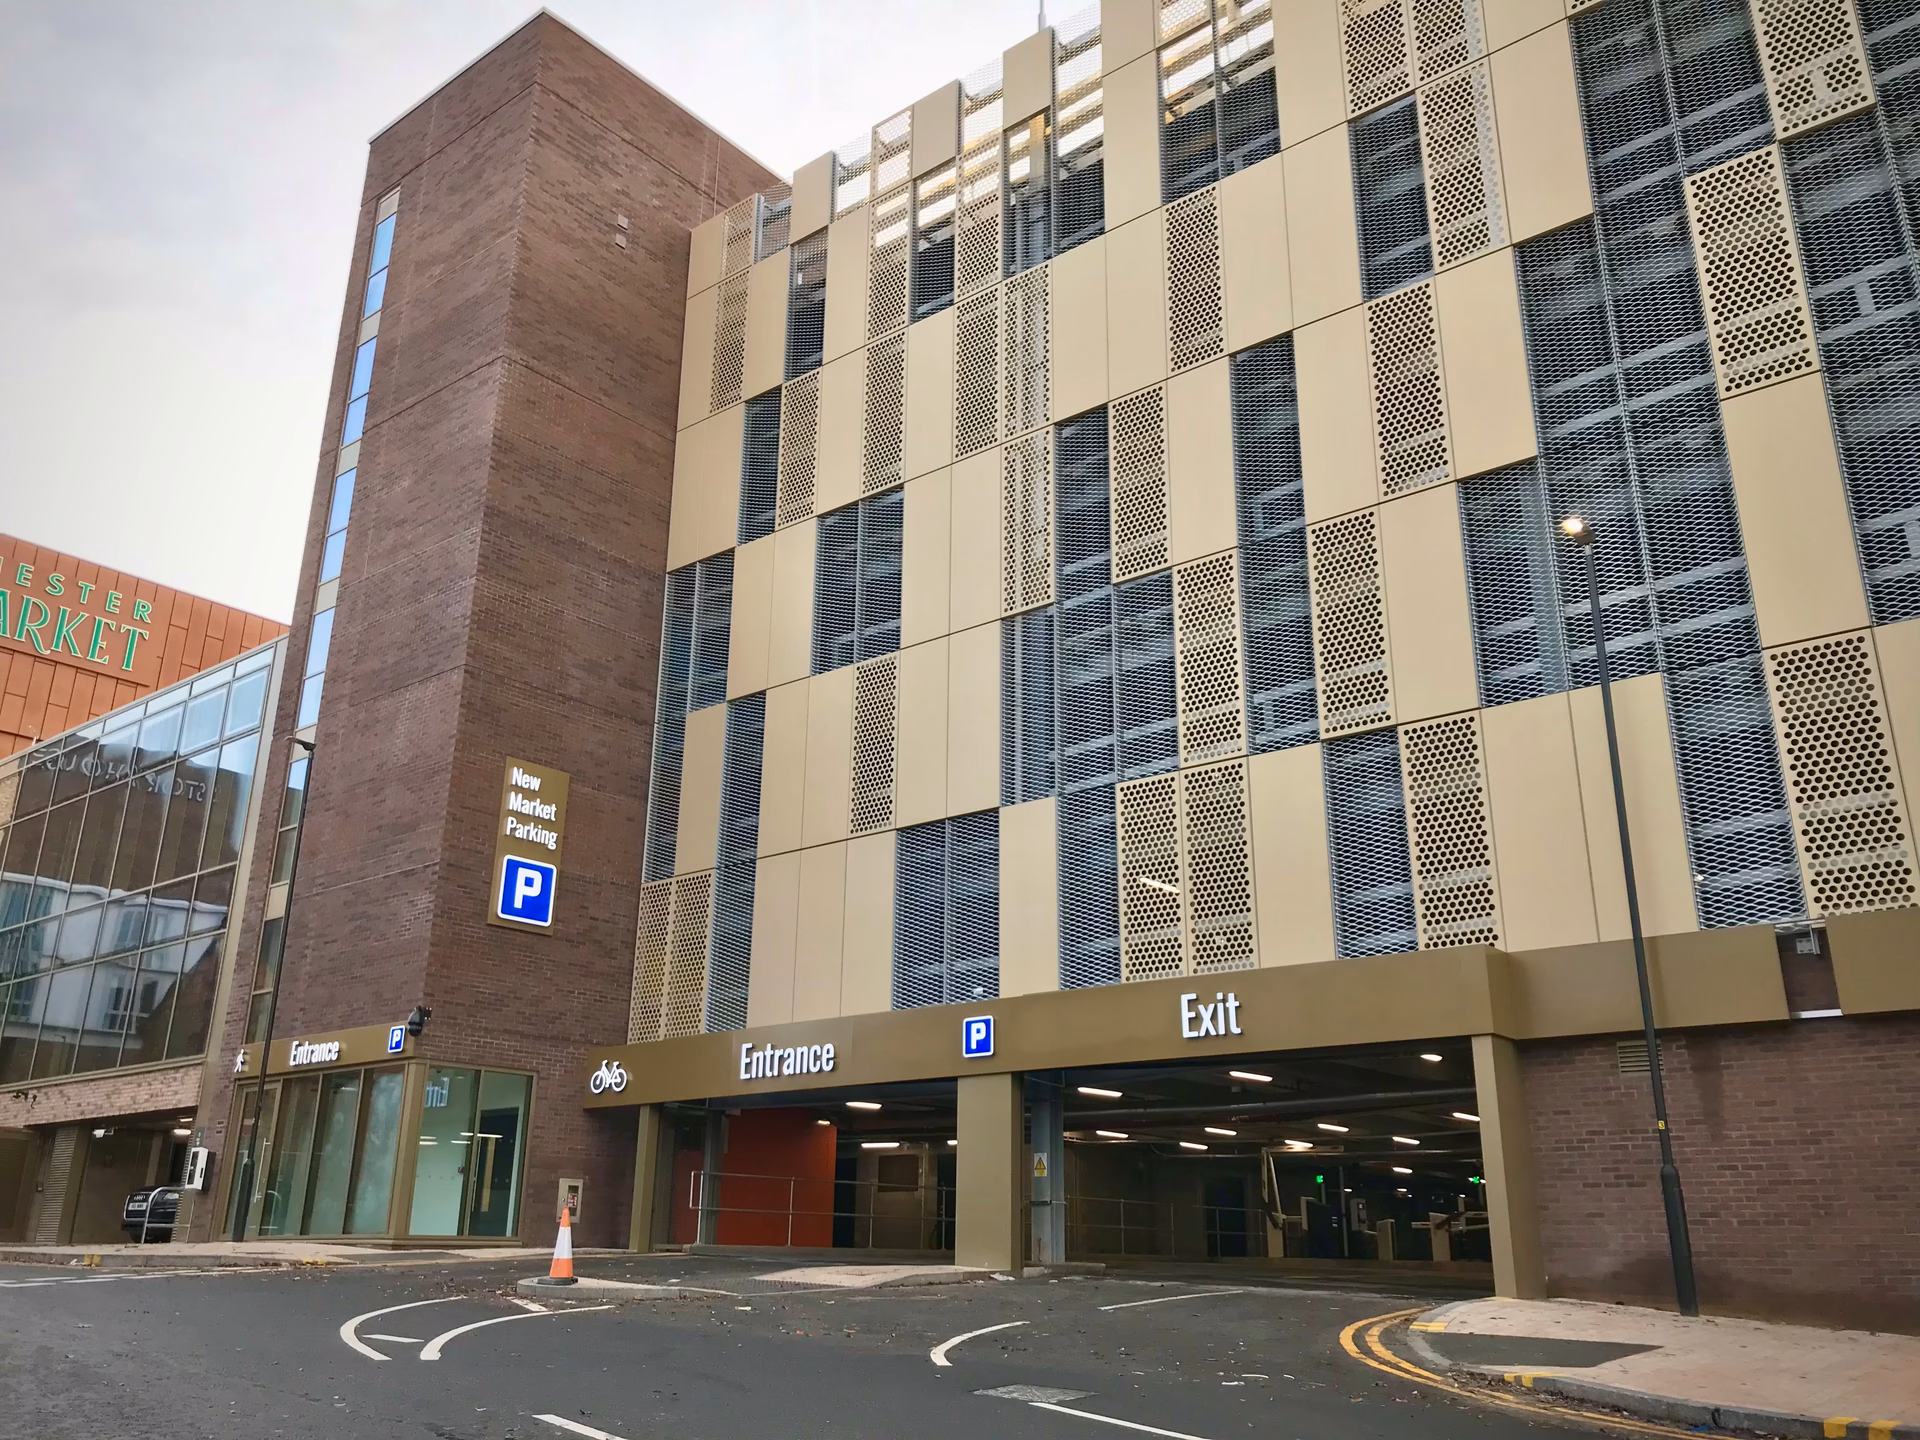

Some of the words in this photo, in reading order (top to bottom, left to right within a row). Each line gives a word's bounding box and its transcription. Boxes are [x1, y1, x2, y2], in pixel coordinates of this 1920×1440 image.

[0, 557, 152, 624] ESTER
[511, 766, 541, 791] New
[508, 791, 557, 821] Market
[506, 816, 558, 850] Parking
[514, 867, 542, 909] P
[1180, 992, 1242, 1038] Exit
[392, 1029, 401, 1048] P
[971, 1022, 986, 1049] P
[289, 1040, 340, 1066] Entrance
[740, 1043, 835, 1079] Entrance
